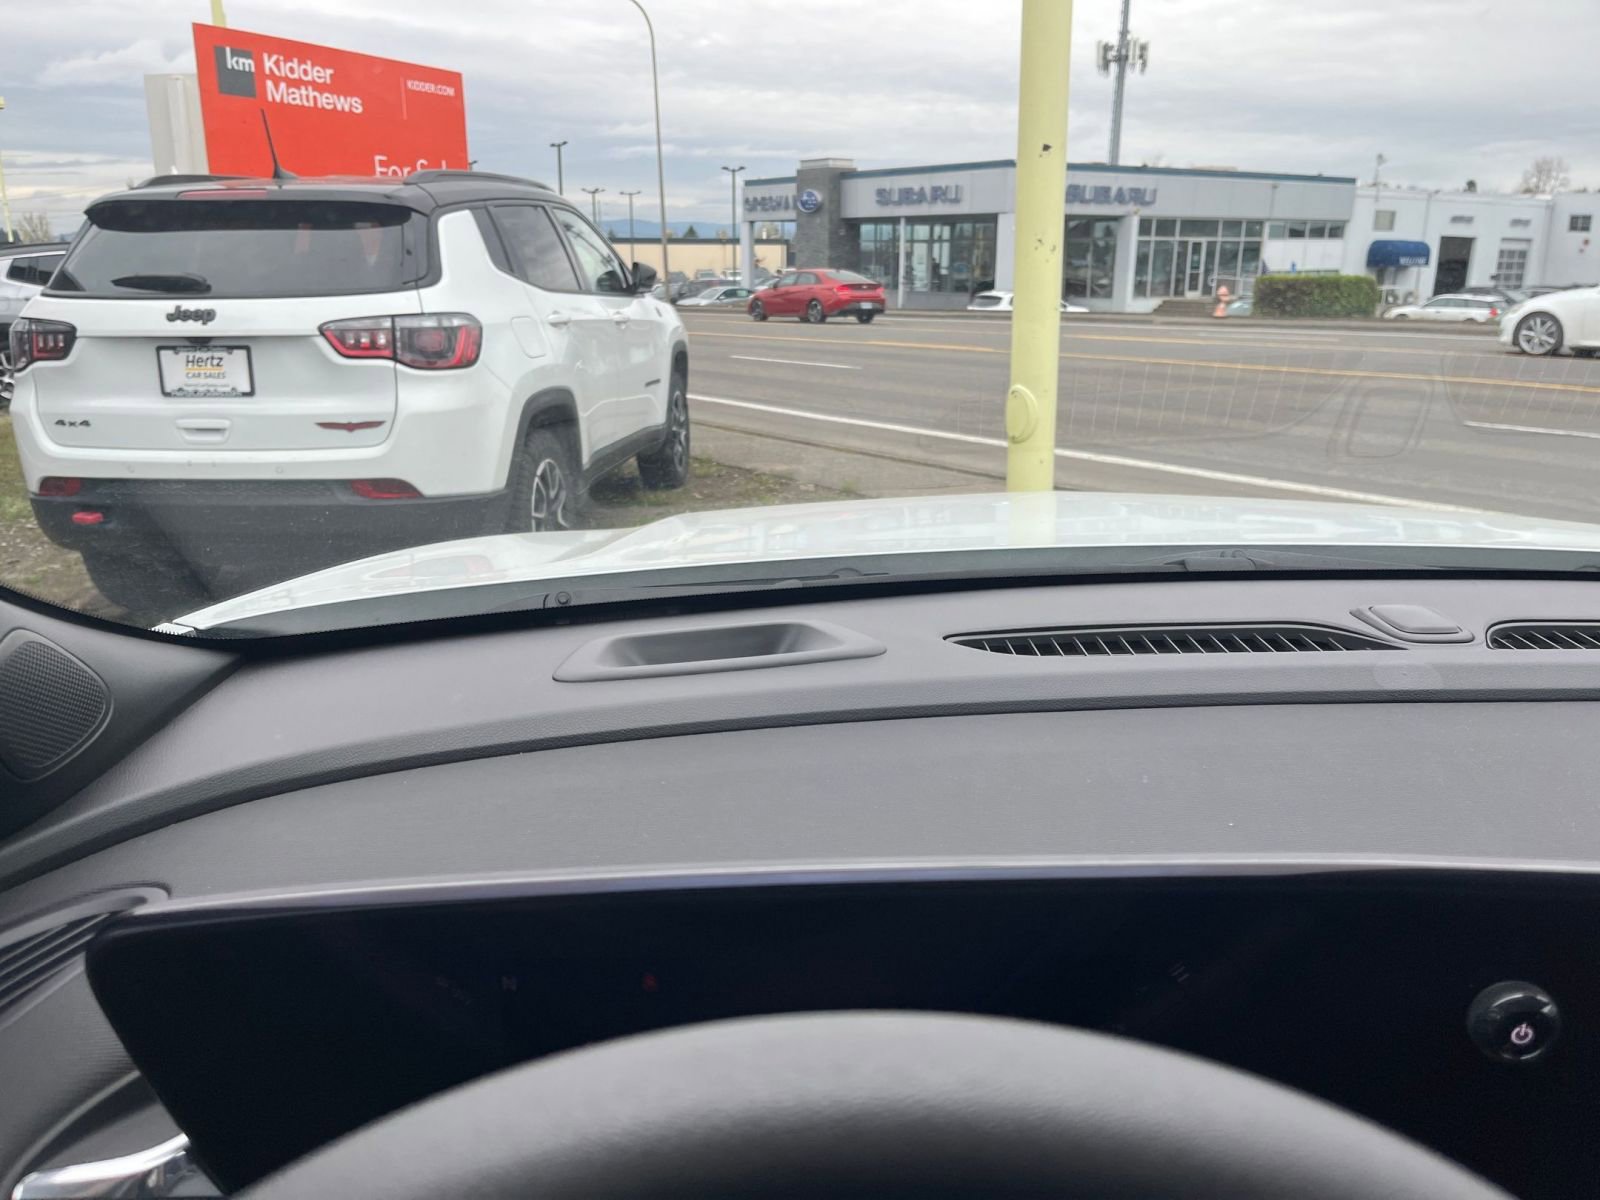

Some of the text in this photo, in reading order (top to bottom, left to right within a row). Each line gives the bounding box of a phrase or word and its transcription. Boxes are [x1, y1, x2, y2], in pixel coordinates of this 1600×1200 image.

[225, 47, 255, 73] km
[263, 53, 334, 84] Kidder
[266, 80, 363, 114] Mathews
[875, 184, 963, 207] SUBARU
[1065, 184, 1157, 206] SUBARU
[166, 305, 216, 325] Jeep
[185, 355, 224, 367] Hertz
[54, 419, 91, 428] 4x4
